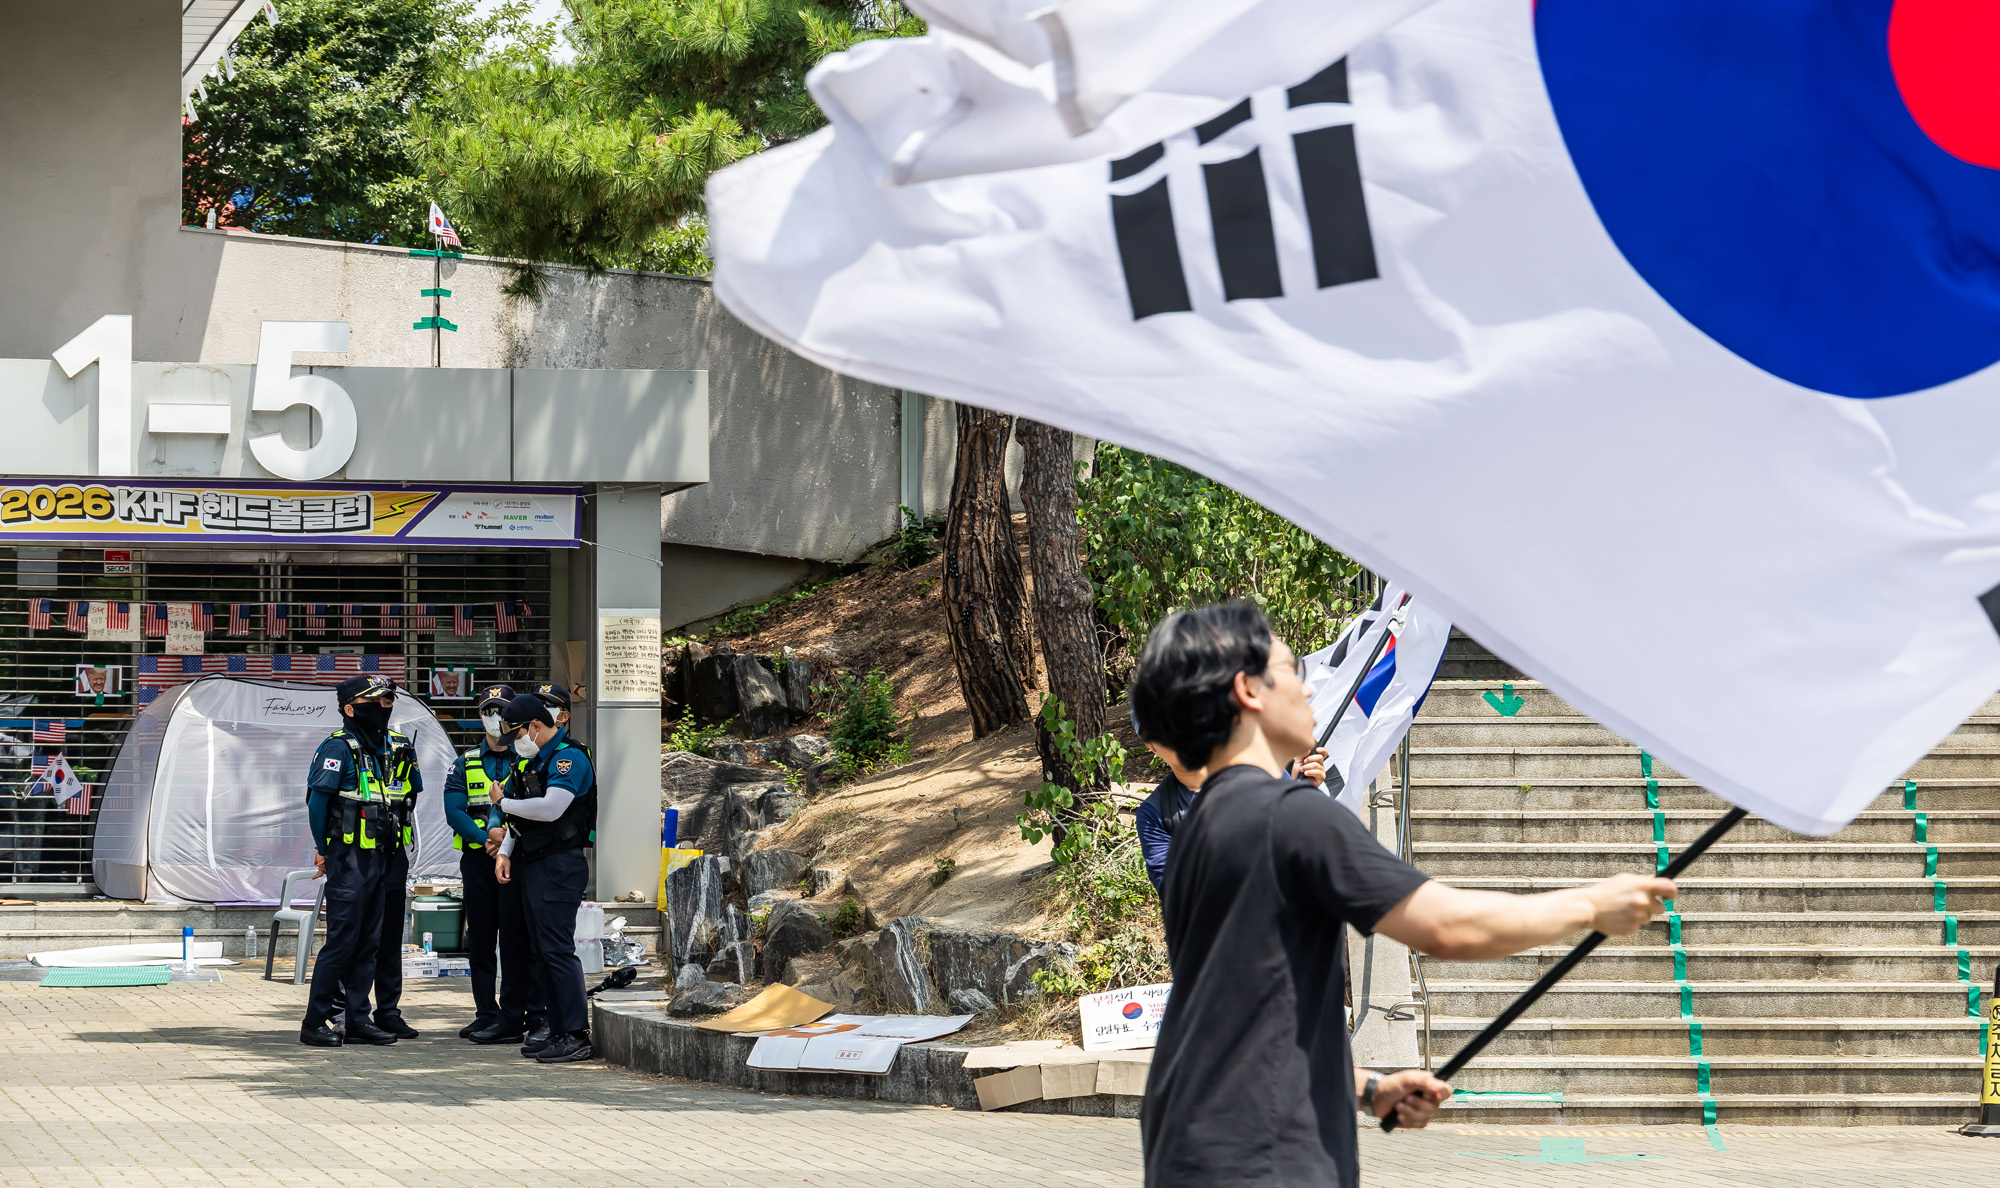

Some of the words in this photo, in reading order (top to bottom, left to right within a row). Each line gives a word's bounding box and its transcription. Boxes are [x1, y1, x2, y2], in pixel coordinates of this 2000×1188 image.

[52, 314, 357, 481] 1-5
[1, 487, 115, 524] 2026
[118, 489, 197, 526] KHF
[202, 493, 371, 533] 핸드볼클럽
[1093, 991, 1132, 1006] 부정선거
[1096, 1024, 1133, 1036] 당일투표
[1142, 1020, 1162, 1031] 수개
